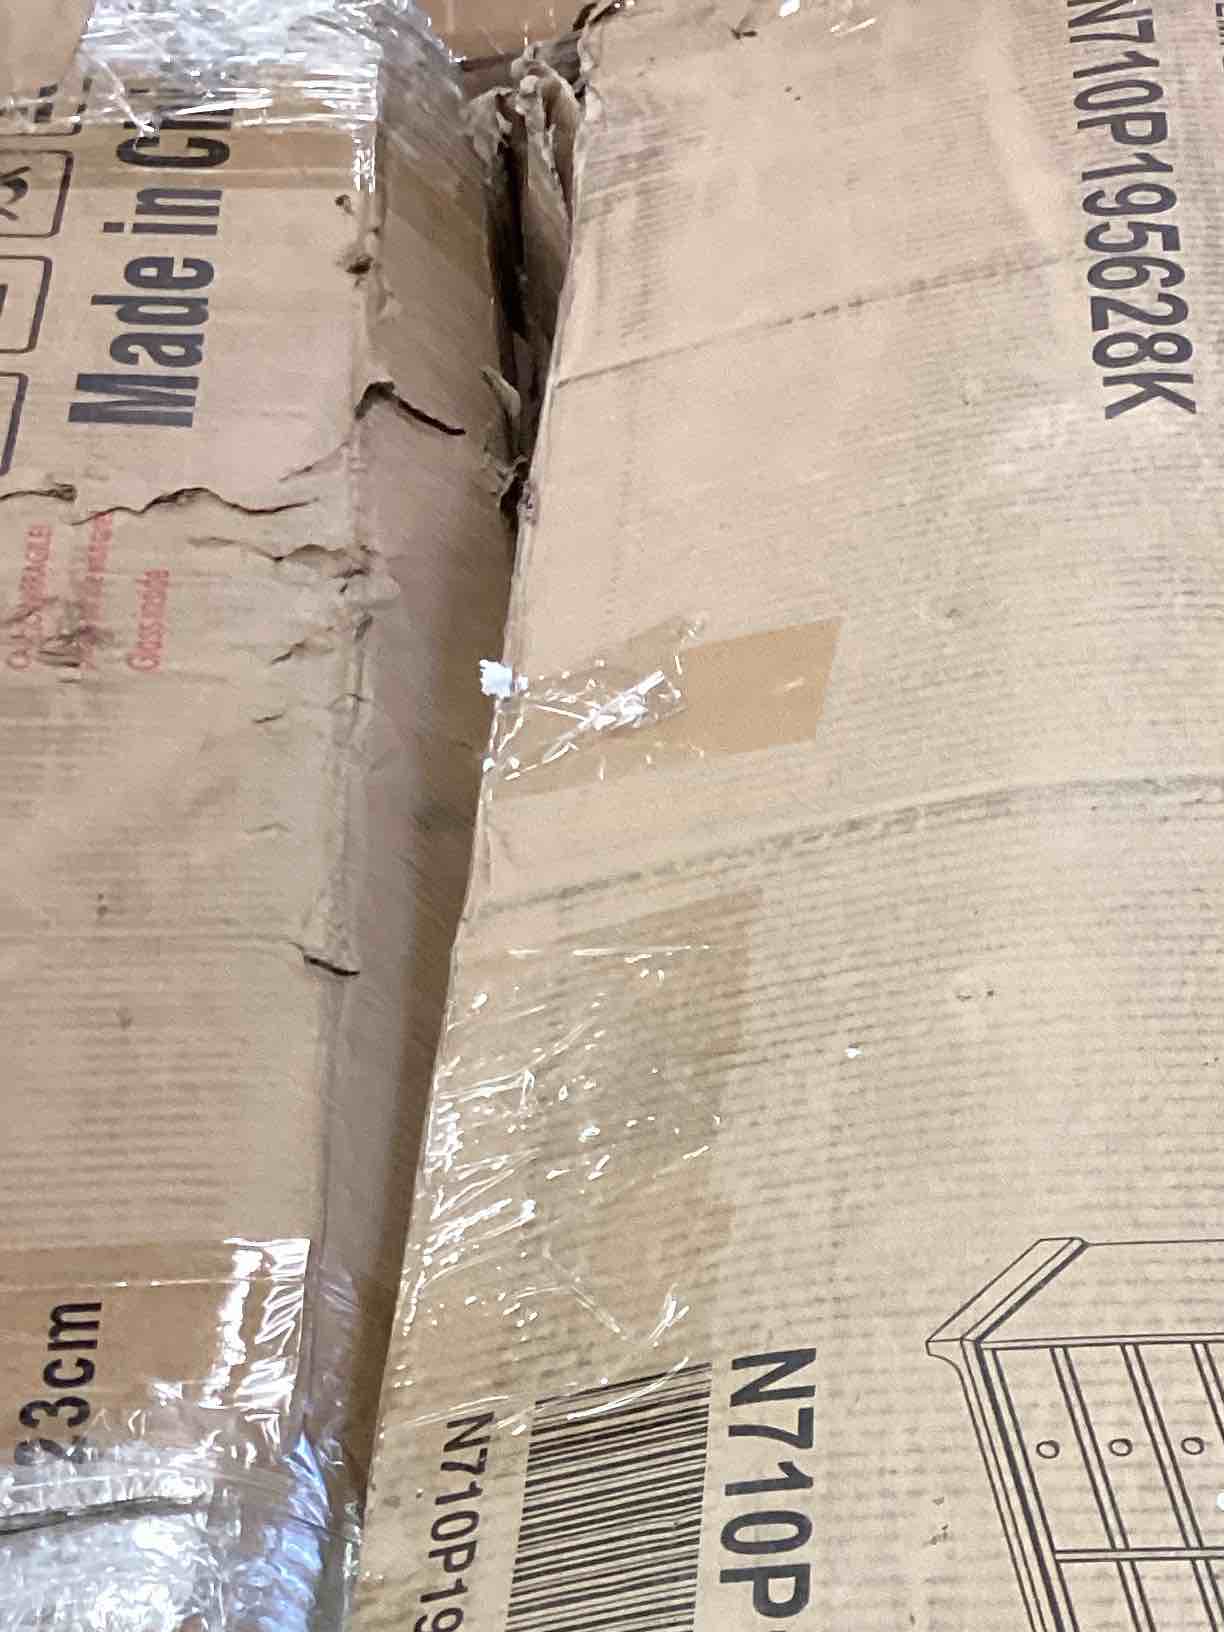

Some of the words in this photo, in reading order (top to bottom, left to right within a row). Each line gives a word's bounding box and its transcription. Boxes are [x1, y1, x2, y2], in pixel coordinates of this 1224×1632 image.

[103, 188, 222, 236] in
[1066, 0, 1197, 419] N710P195628K
[68, 256, 214, 427] Made
